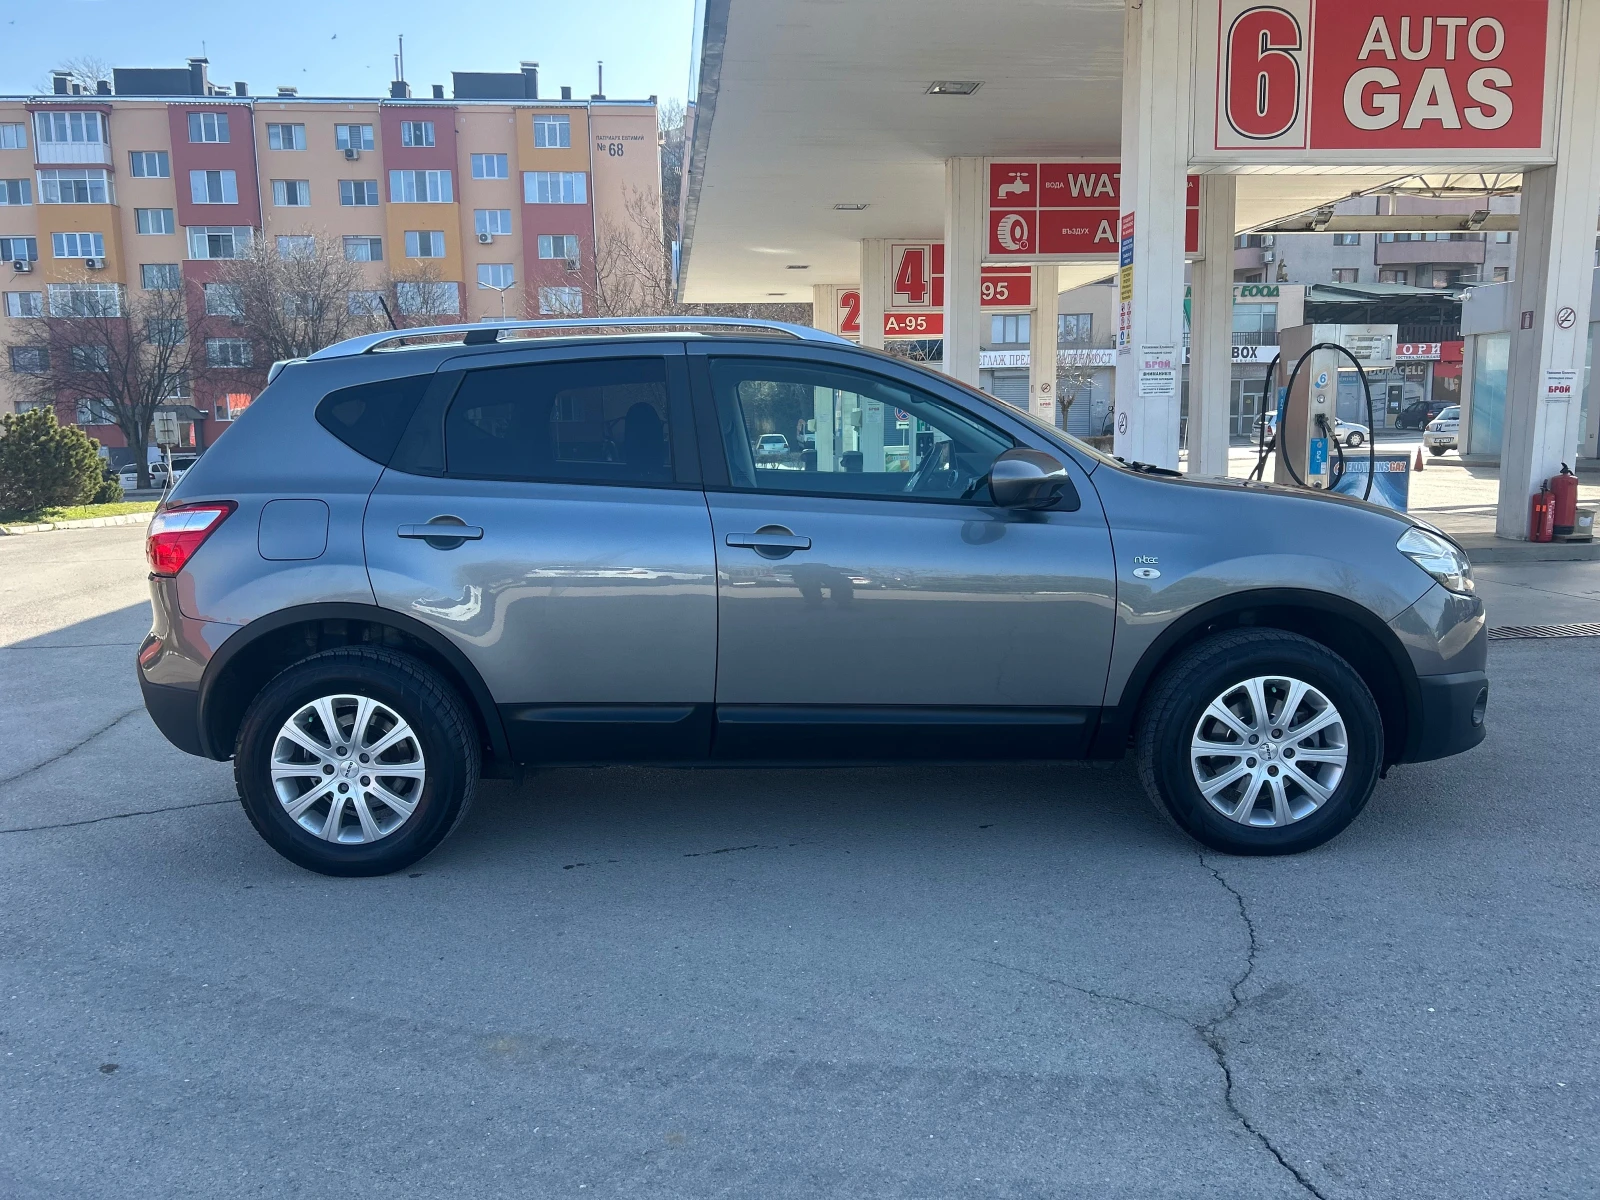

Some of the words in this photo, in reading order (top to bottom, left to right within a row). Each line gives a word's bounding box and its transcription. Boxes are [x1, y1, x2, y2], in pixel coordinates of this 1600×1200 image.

[1357, 15, 1506, 62] AUTO
[1225, 5, 1303, 140] 6
[1343, 66, 1514, 131] GAS
[609, 143, 624, 157] 68
[1045, 181, 1065, 189] ВОДА
[1062, 227, 1089, 235] ВЪЗДУХ
[893, 248, 928, 303] 4
[1241, 285, 1280, 297] ЕООД
[840, 290, 861, 334] 2
[1231, 346, 1258, 359] BOX
[1396, 344, 1441, 355] ОРИ
[1145, 360, 1171, 369] БРОЙ
[1320, 373, 1327, 383] 6
[1548, 385, 1571, 394] БРОЙ
